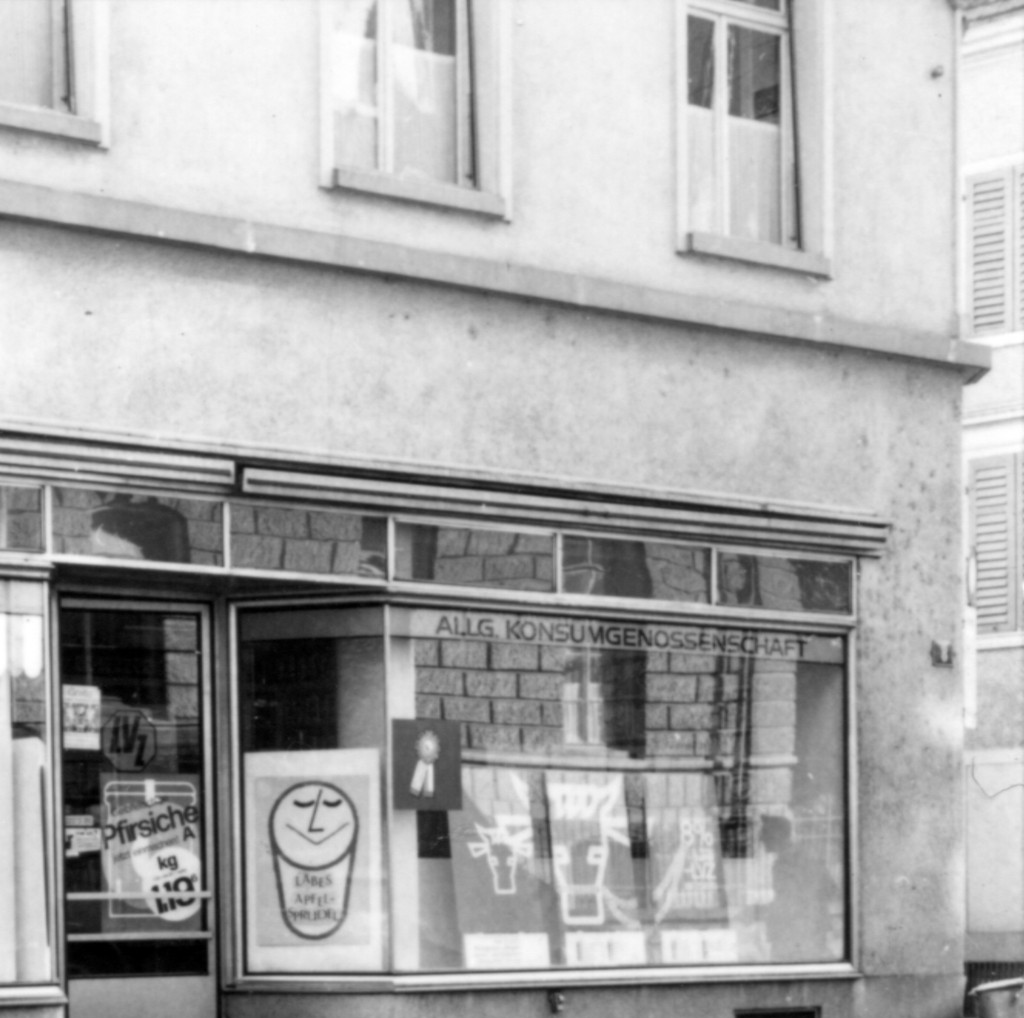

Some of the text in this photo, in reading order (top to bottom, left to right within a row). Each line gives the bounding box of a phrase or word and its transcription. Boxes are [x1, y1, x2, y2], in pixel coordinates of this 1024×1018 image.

[436, 615, 808, 658] ALLG. KONSUMGENOSSENSCHAFT
[102, 804, 199, 850] Pfirsiche
[157, 855, 178, 871] kg
